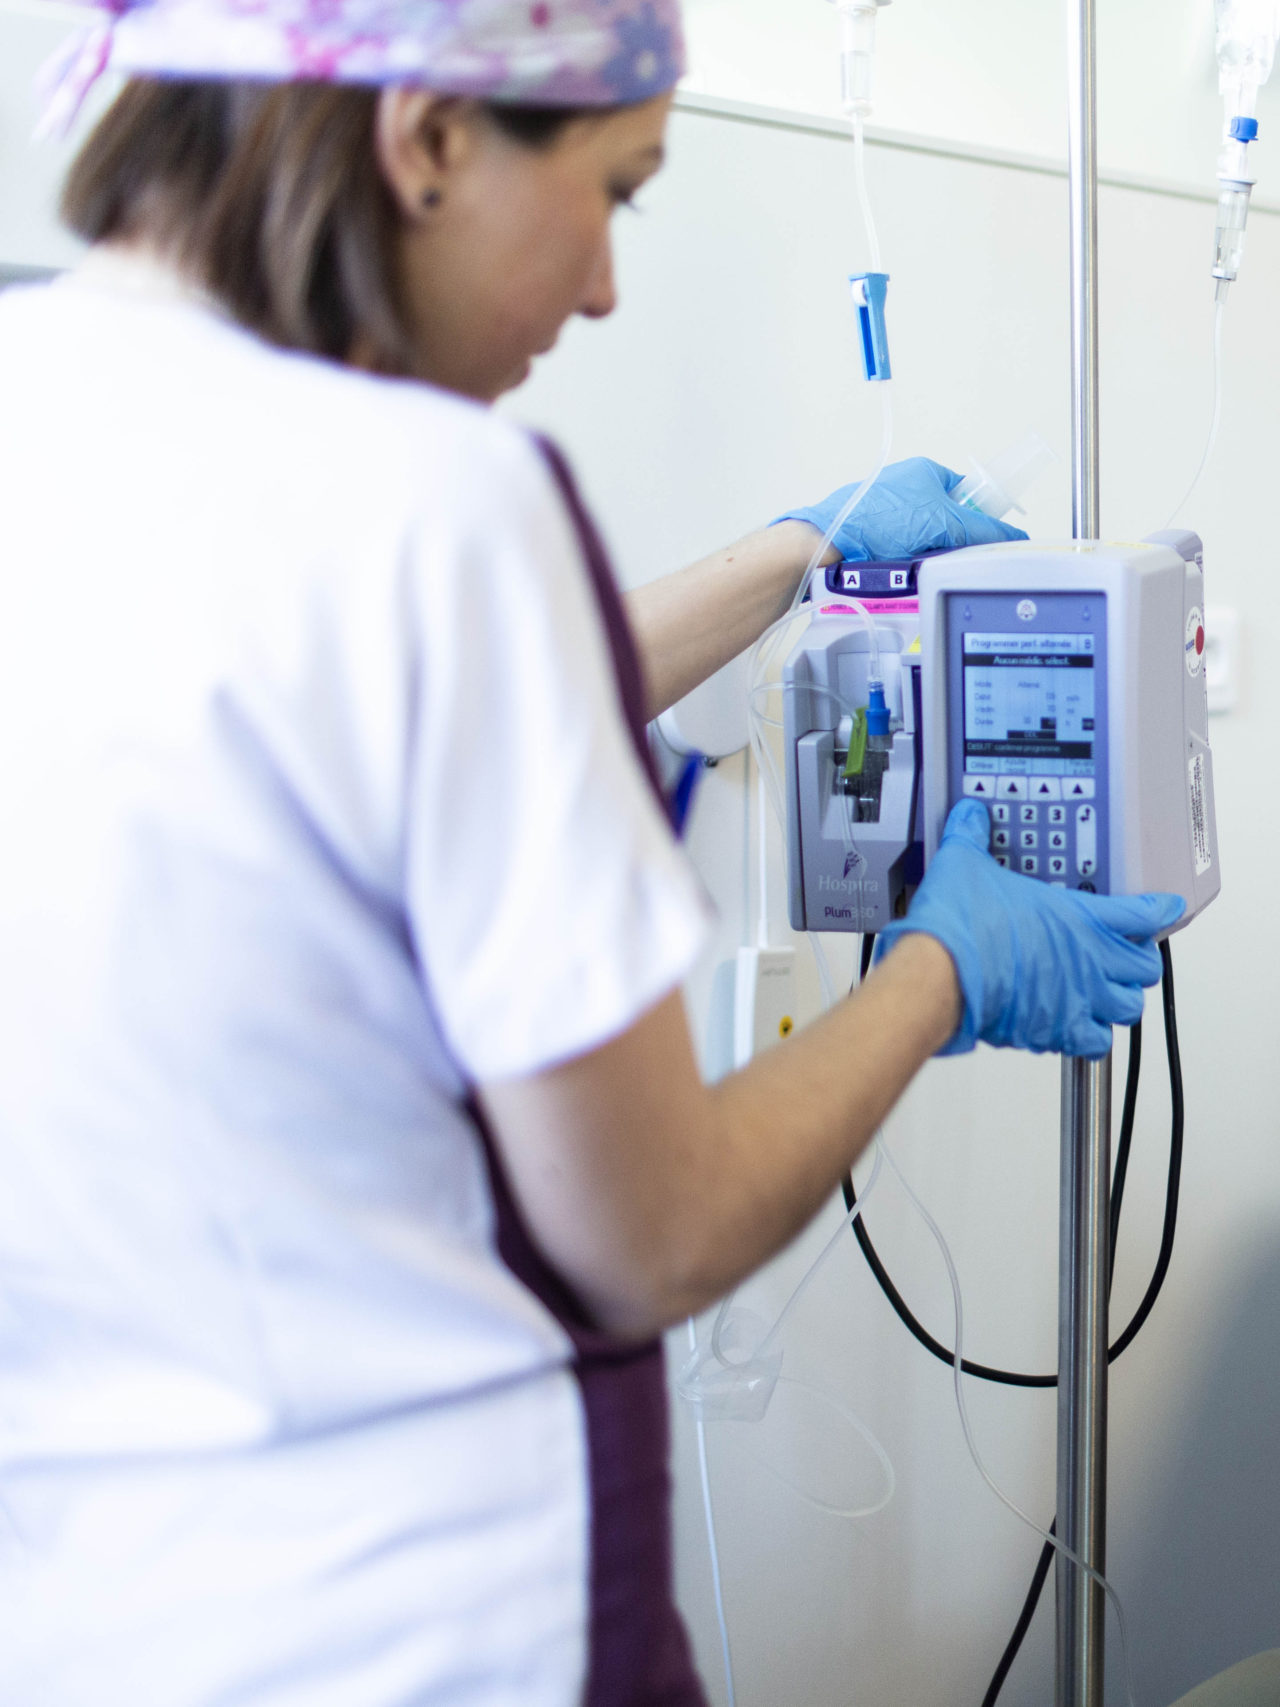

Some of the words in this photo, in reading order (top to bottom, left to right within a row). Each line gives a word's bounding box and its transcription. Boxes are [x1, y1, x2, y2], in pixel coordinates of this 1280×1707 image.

[847, 575, 857, 585] A
[895, 575, 904, 584] B
[998, 808, 1004, 819] 1
[1024, 808, 1033, 820] 2
[1053, 809, 1062, 820] 3
[996, 833, 1006, 845] 4
[1025, 834, 1033, 845] 5
[1053, 834, 1062, 846] 6
[1025, 859, 1034, 871] 8
[1053, 860, 1062, 871] 9
[818, 874, 879, 895] Hospira
